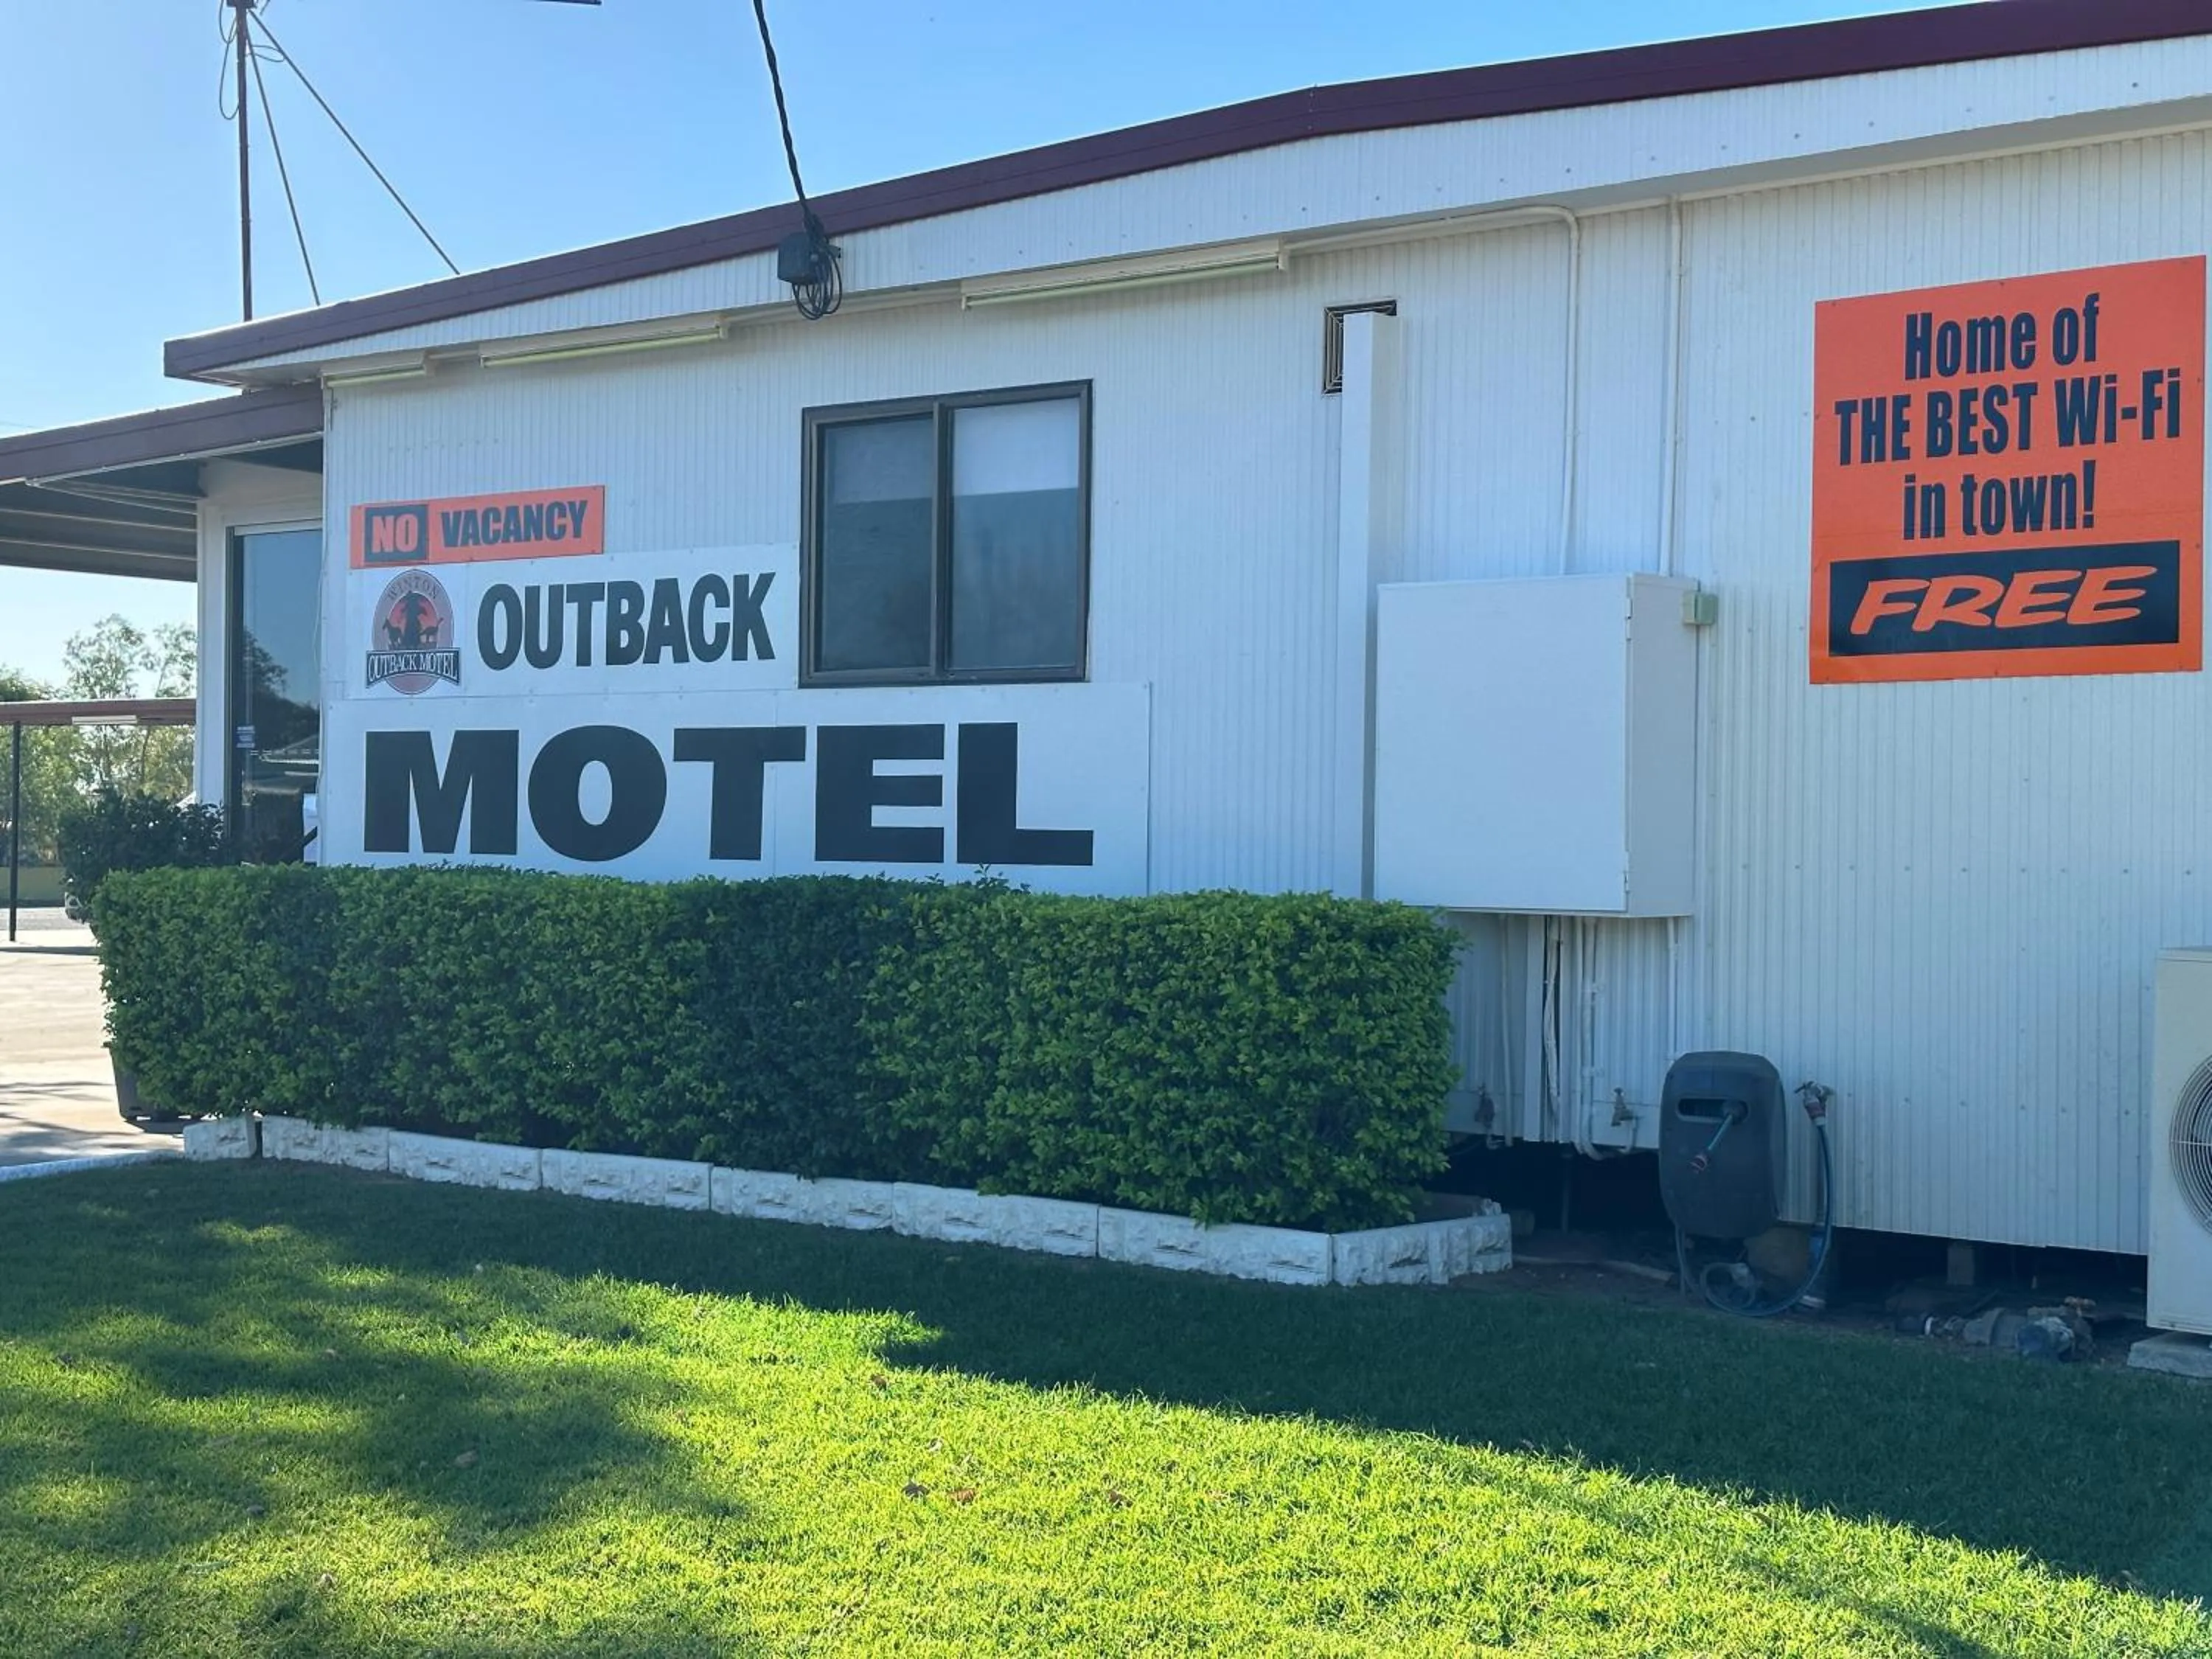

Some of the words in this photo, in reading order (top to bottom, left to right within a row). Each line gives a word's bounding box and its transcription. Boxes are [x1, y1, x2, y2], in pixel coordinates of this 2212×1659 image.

[1905, 312, 2036, 380] Home
[2053, 293, 2099, 366] of
[1834, 394, 1911, 466] THE
[1926, 383, 2038, 458] BEST
[2054, 368, 2180, 448] Wi-Fi
[371, 513, 418, 552] NO
[440, 500, 588, 547] VACANCY
[1903, 474, 1945, 540] in
[1961, 460, 2096, 536] town!
[388, 575, 438, 600] WINTON
[477, 572, 776, 670] OUTBACK
[1850, 566, 2157, 634] FREE
[369, 653, 417, 682] OUTBACK
[420, 653, 457, 680] MOTEL
[364, 722, 1094, 866] MOTEL
